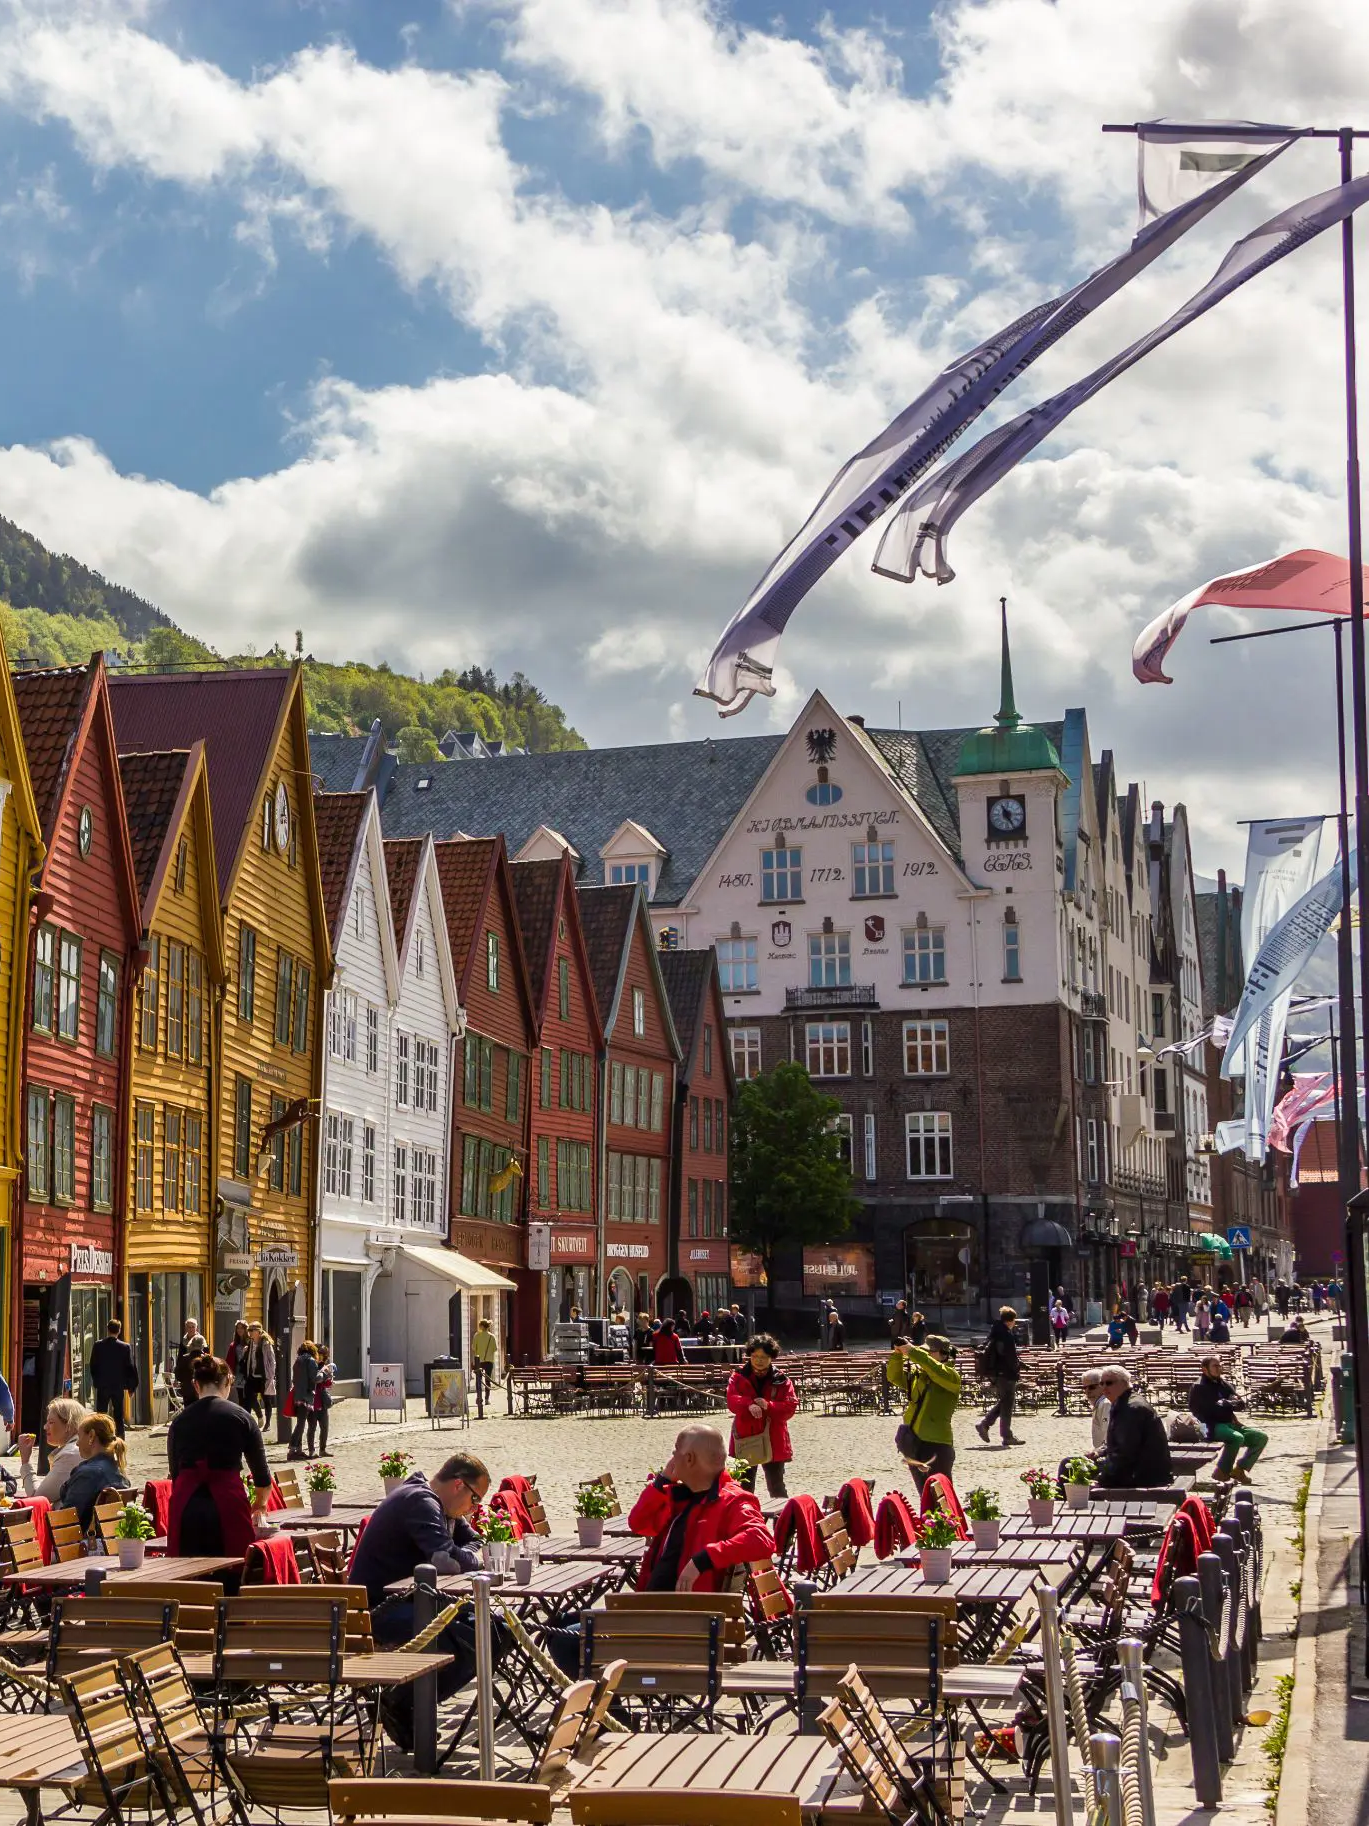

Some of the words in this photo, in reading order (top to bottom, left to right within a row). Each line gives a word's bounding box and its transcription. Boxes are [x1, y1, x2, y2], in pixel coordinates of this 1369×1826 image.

[810, 868, 845, 882] 1712.
[903, 862, 938, 876] 1912.
[375, 1377, 395, 1388] ÅPEN
